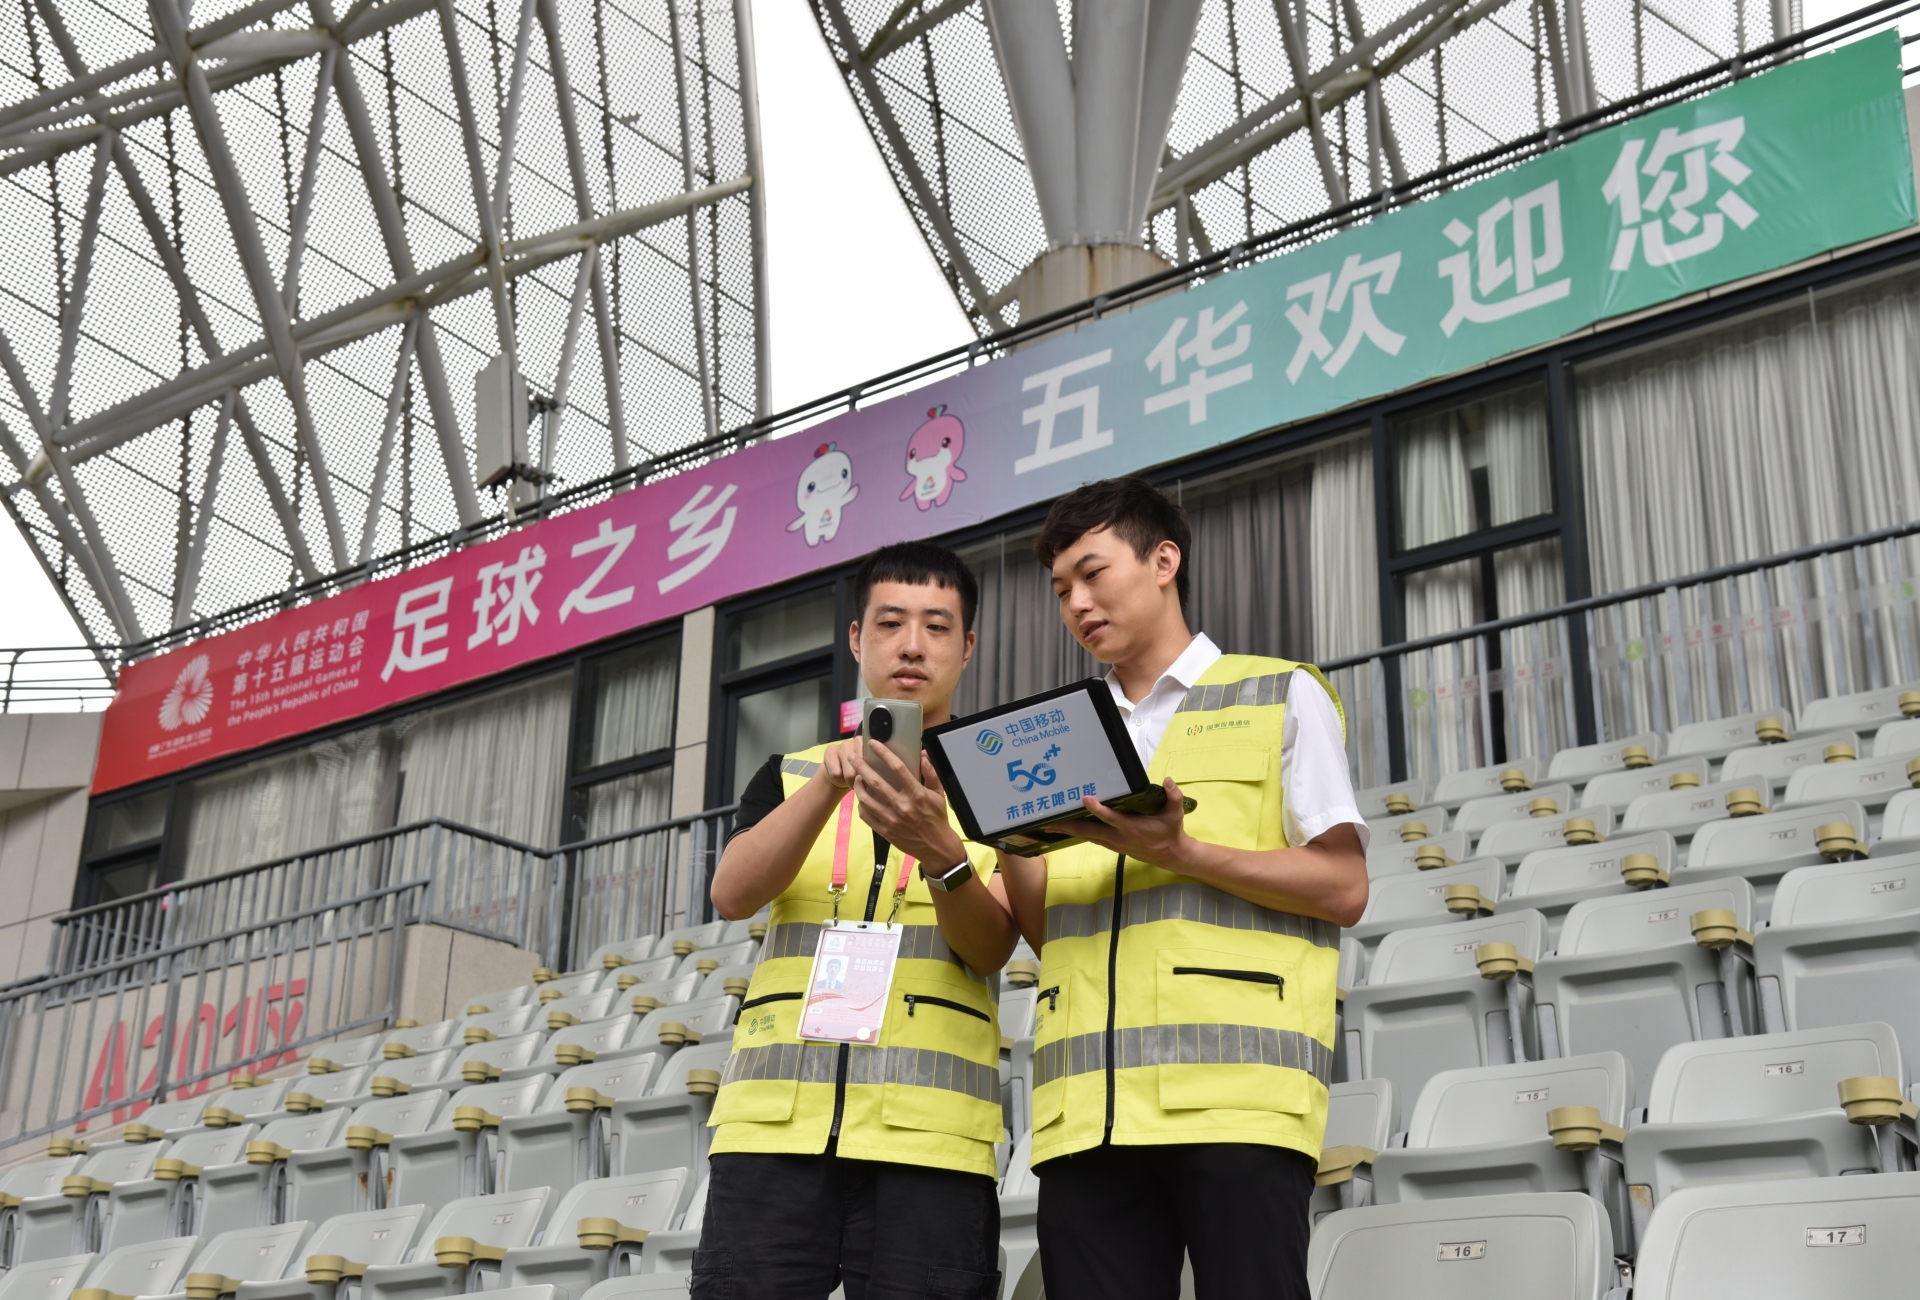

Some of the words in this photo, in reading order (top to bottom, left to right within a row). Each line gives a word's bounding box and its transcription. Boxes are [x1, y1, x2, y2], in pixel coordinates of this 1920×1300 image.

[379, 483, 738, 683] 足球之乡
[1014, 116, 1761, 475] 五华欢迎您
[237, 609, 370, 670] 中华人民共和国
[232, 635, 365, 696] 第十五届运动会
[230, 699, 247, 711] The
[250, 690, 270, 705] 15th
[273, 675, 313, 698] National
[315, 667, 348, 684] Games
[350, 659, 362, 673] of
[227, 715, 241, 727] the
[243, 703, 280, 721] People's
[281, 691, 319, 709] Republic
[321, 684, 331, 698] of
[332, 678, 359, 694] China
[1005, 709, 1065, 736] 中国移动
[1012, 734, 1039, 748] China
[1040, 724, 1070, 740] Mobile
[1006, 783, 1097, 820] 未来无限可能
[1882, 882, 1895, 890] 16
[1658, 912, 1669, 920] 15
[1778, 1065, 1792, 1074] 16
[1527, 1092, 1539, 1100] 15
[1827, 1231, 1847, 1243] 17
[1454, 1246, 1471, 1257] 16
